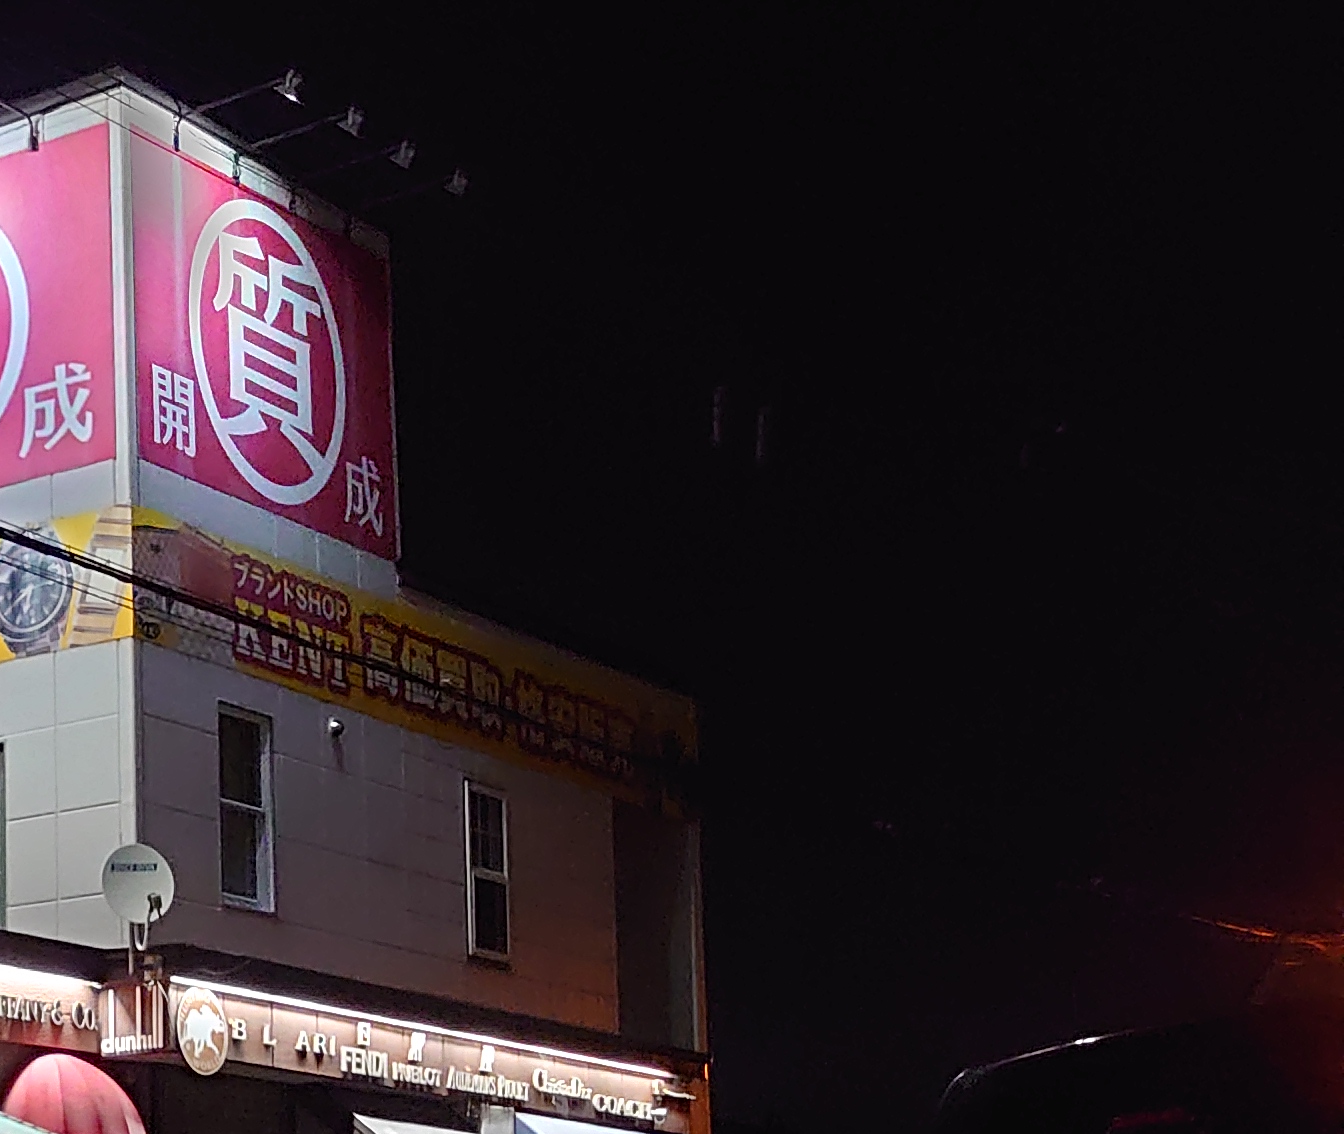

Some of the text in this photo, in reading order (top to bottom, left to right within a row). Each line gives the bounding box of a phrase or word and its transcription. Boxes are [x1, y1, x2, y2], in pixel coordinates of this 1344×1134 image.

[215, 232, 322, 458] 質
[19, 362, 95, 458] 成
[152, 364, 198, 458] 開
[344, 457, 385, 537] 成
[101, 986, 164, 1055] dunhill
[339, 1045, 390, 1080] FENDI
[391, 1061, 442, 1088] HUBLOT
[592, 1093, 653, 1121] COACH
